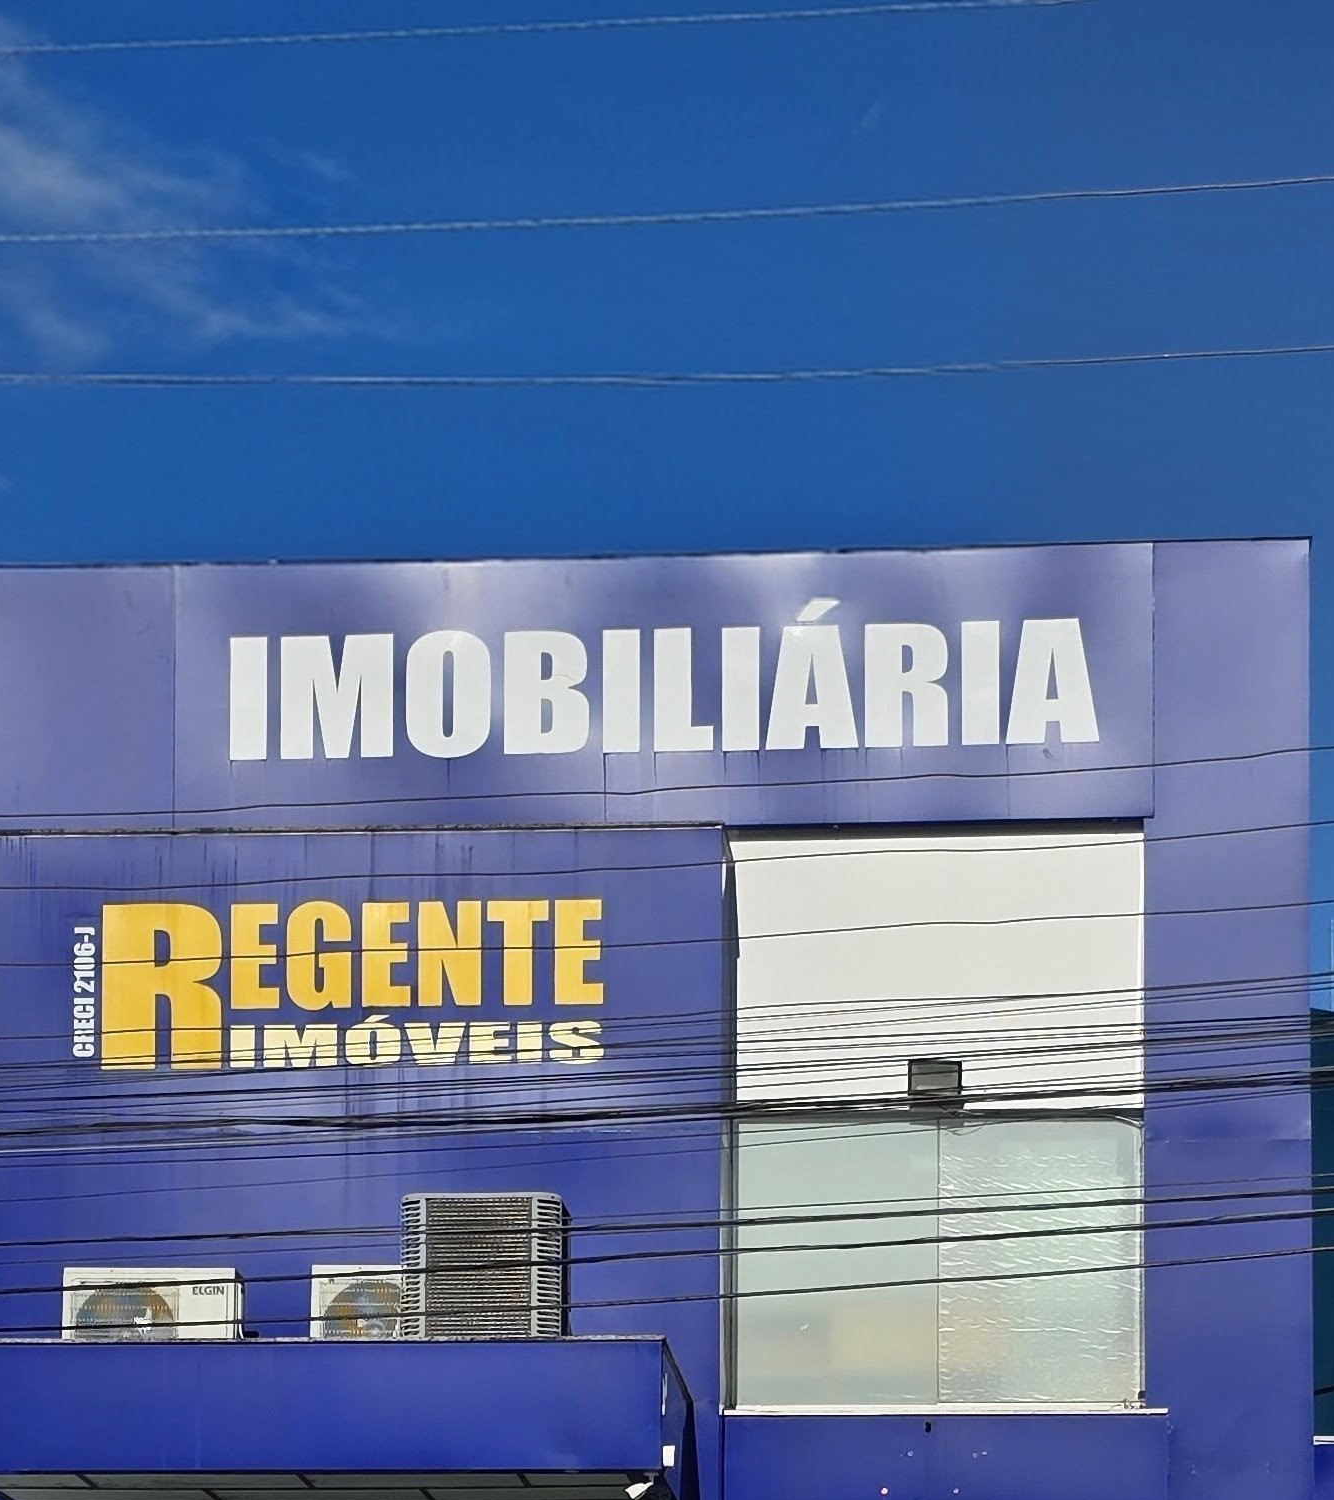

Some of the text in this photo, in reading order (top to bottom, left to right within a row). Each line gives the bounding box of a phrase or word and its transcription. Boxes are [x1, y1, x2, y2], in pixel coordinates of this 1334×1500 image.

[229, 598, 1100, 761] IMOBILIÁRIA
[73, 926, 95, 1058] CRECI 2106-J
[101, 899, 604, 1070] REGENTE
[229, 1014, 605, 1068] IMÓVEIS
[192, 1286, 225, 1296] ELGIN
